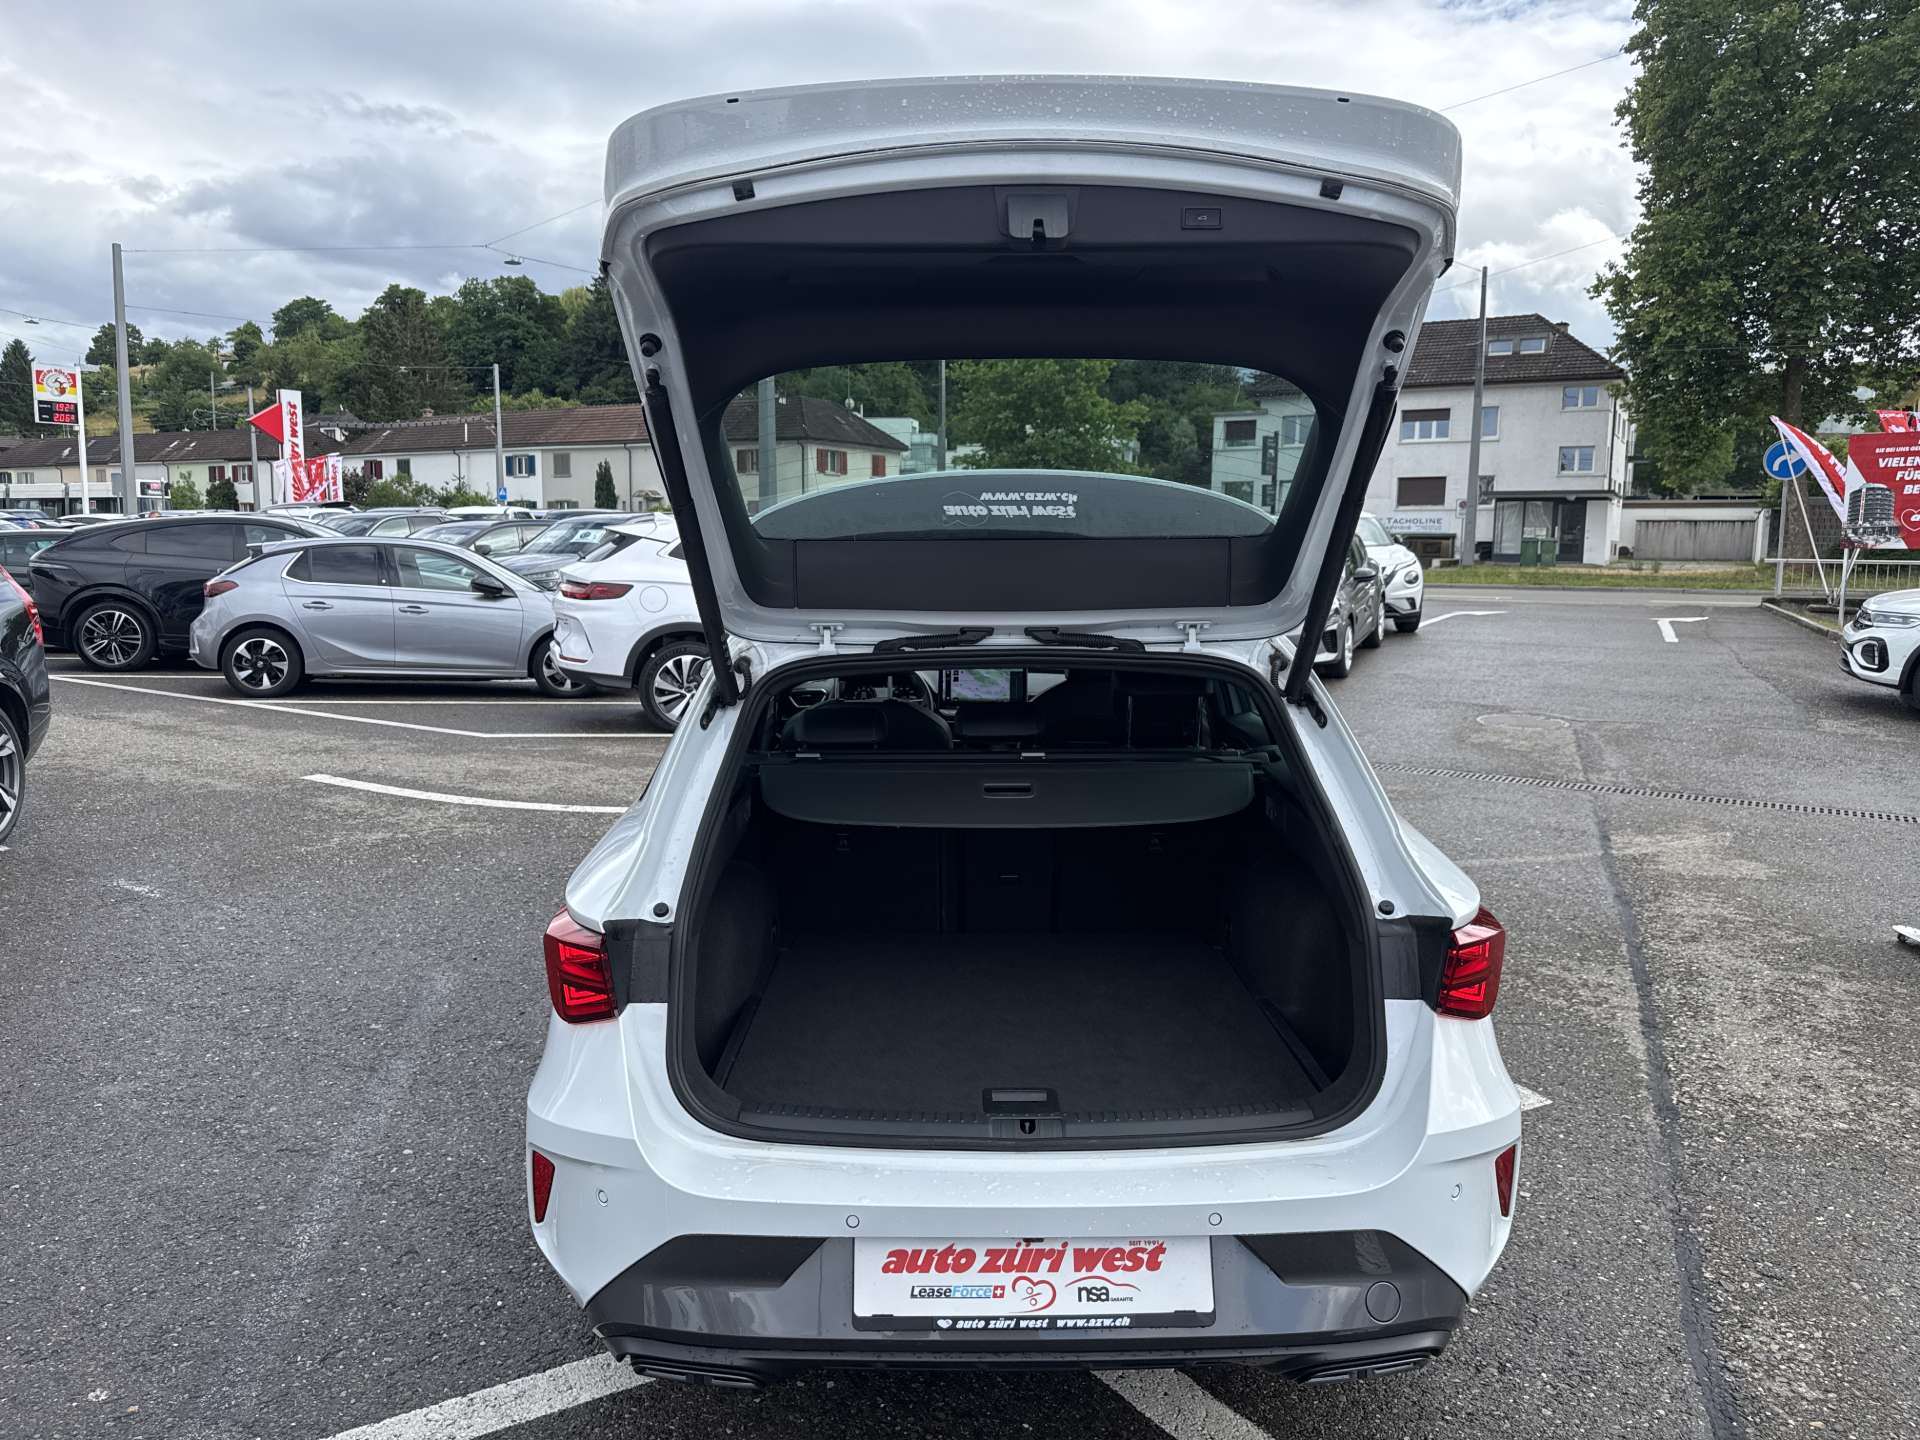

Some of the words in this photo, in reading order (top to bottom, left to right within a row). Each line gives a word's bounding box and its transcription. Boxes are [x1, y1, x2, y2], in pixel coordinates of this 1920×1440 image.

[287, 401, 299, 438] west
[882, 1242, 976, 1273] auto
[978, 1241, 1068, 1273] züri
[1073, 1242, 1167, 1273] west
[911, 1286, 992, 1298] LeaseForce
[1078, 1286, 1109, 1302] nsa
[956, 1318, 985, 1329] auto
[988, 1318, 1016, 1329] züri
[1019, 1318, 1049, 1328] west
[1056, 1317, 1130, 1328] www.azw.ch
